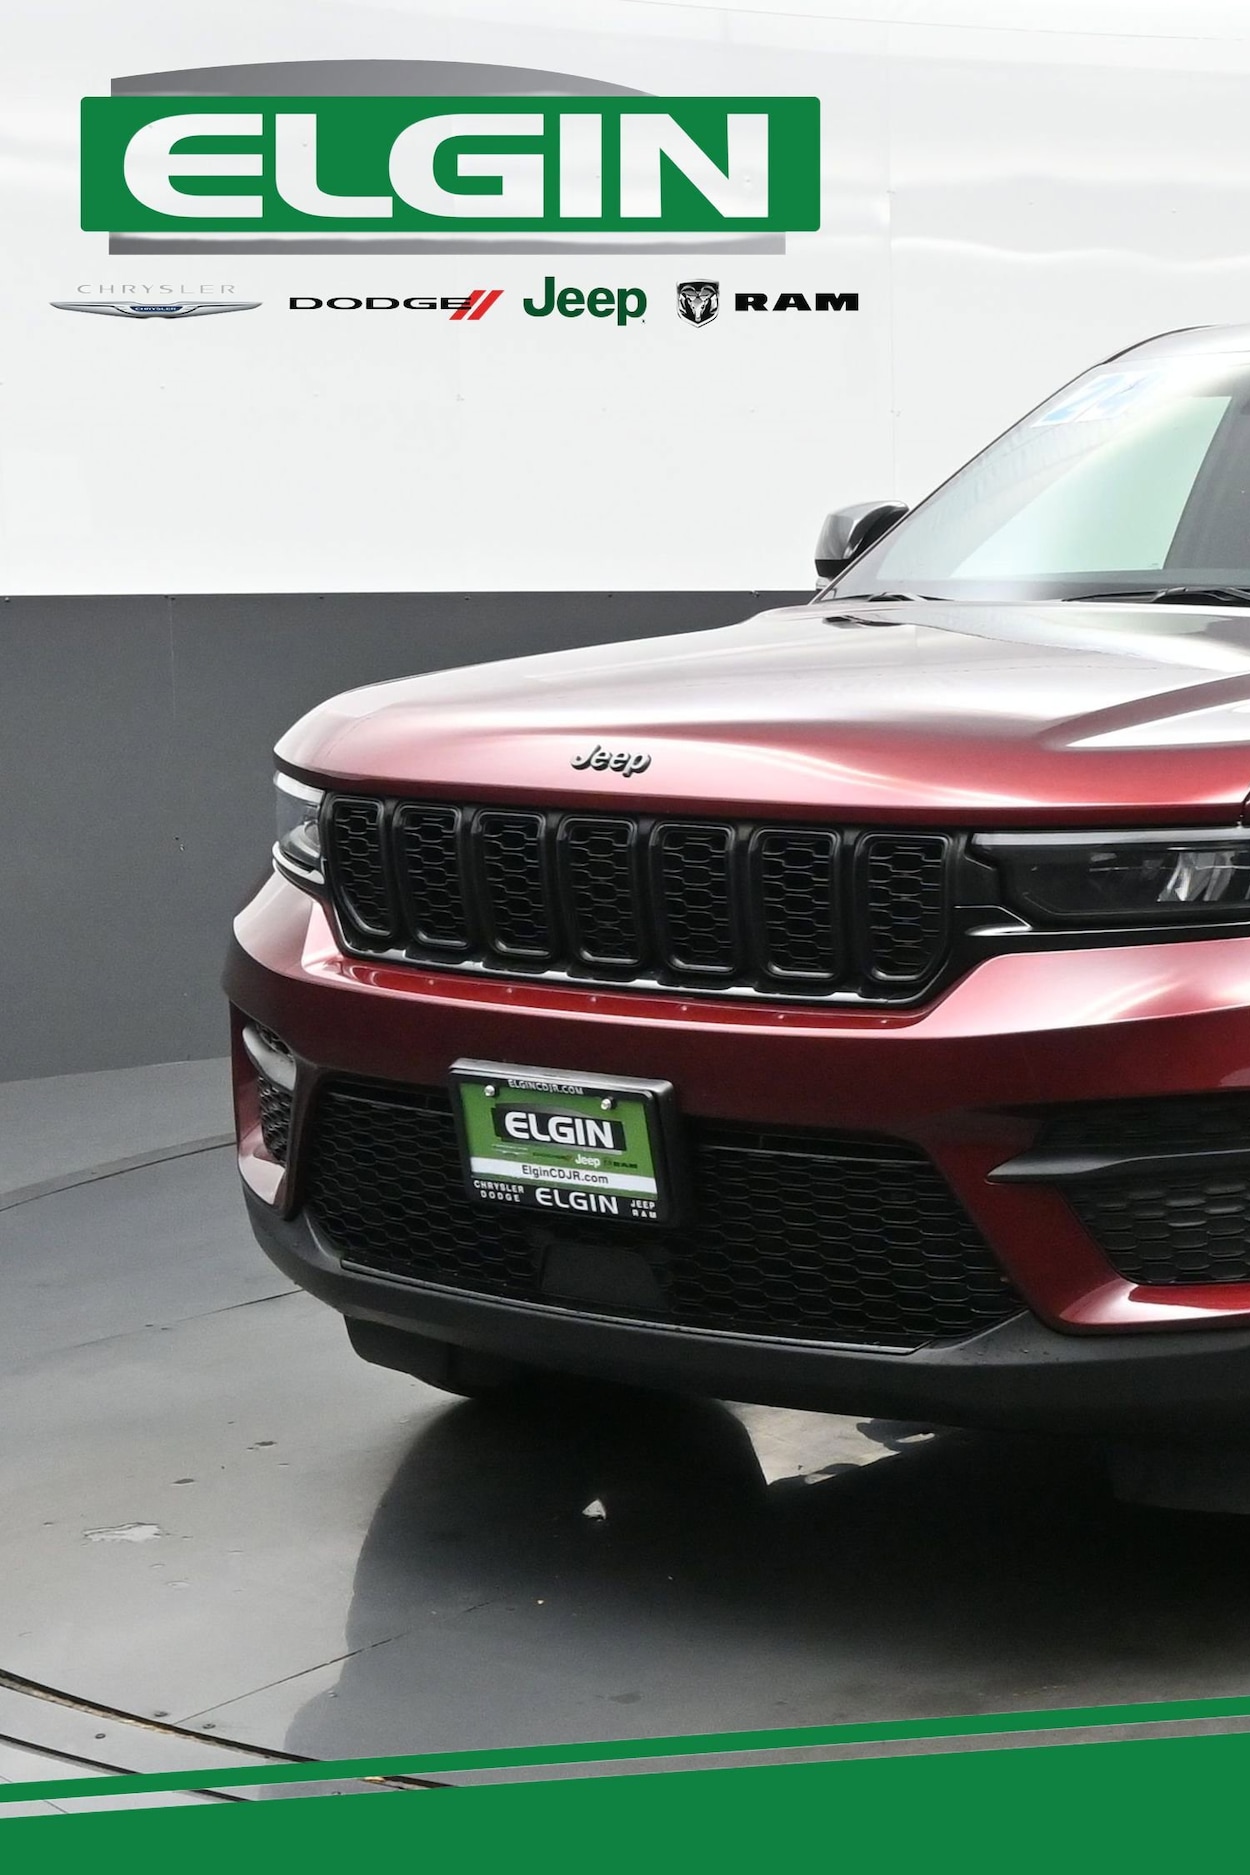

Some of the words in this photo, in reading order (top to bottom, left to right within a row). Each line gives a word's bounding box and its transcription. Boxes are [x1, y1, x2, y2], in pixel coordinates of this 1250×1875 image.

[570, 744, 652, 778] Jeep
[508, 1079, 584, 1096] ELGINCDJR.COM
[504, 1111, 614, 1149] ELGIN
[575, 1153, 601, 1169] Jeep
[521, 1164, 609, 1185] ElginCDJR.com
[473, 1179, 525, 1194] CHRYSLER
[480, 1191, 521, 1203] DODGE
[535, 1187, 619, 1215] ELGIN
[630, 1199, 656, 1210] JEEP
[632, 1209, 657, 1219] RAM
